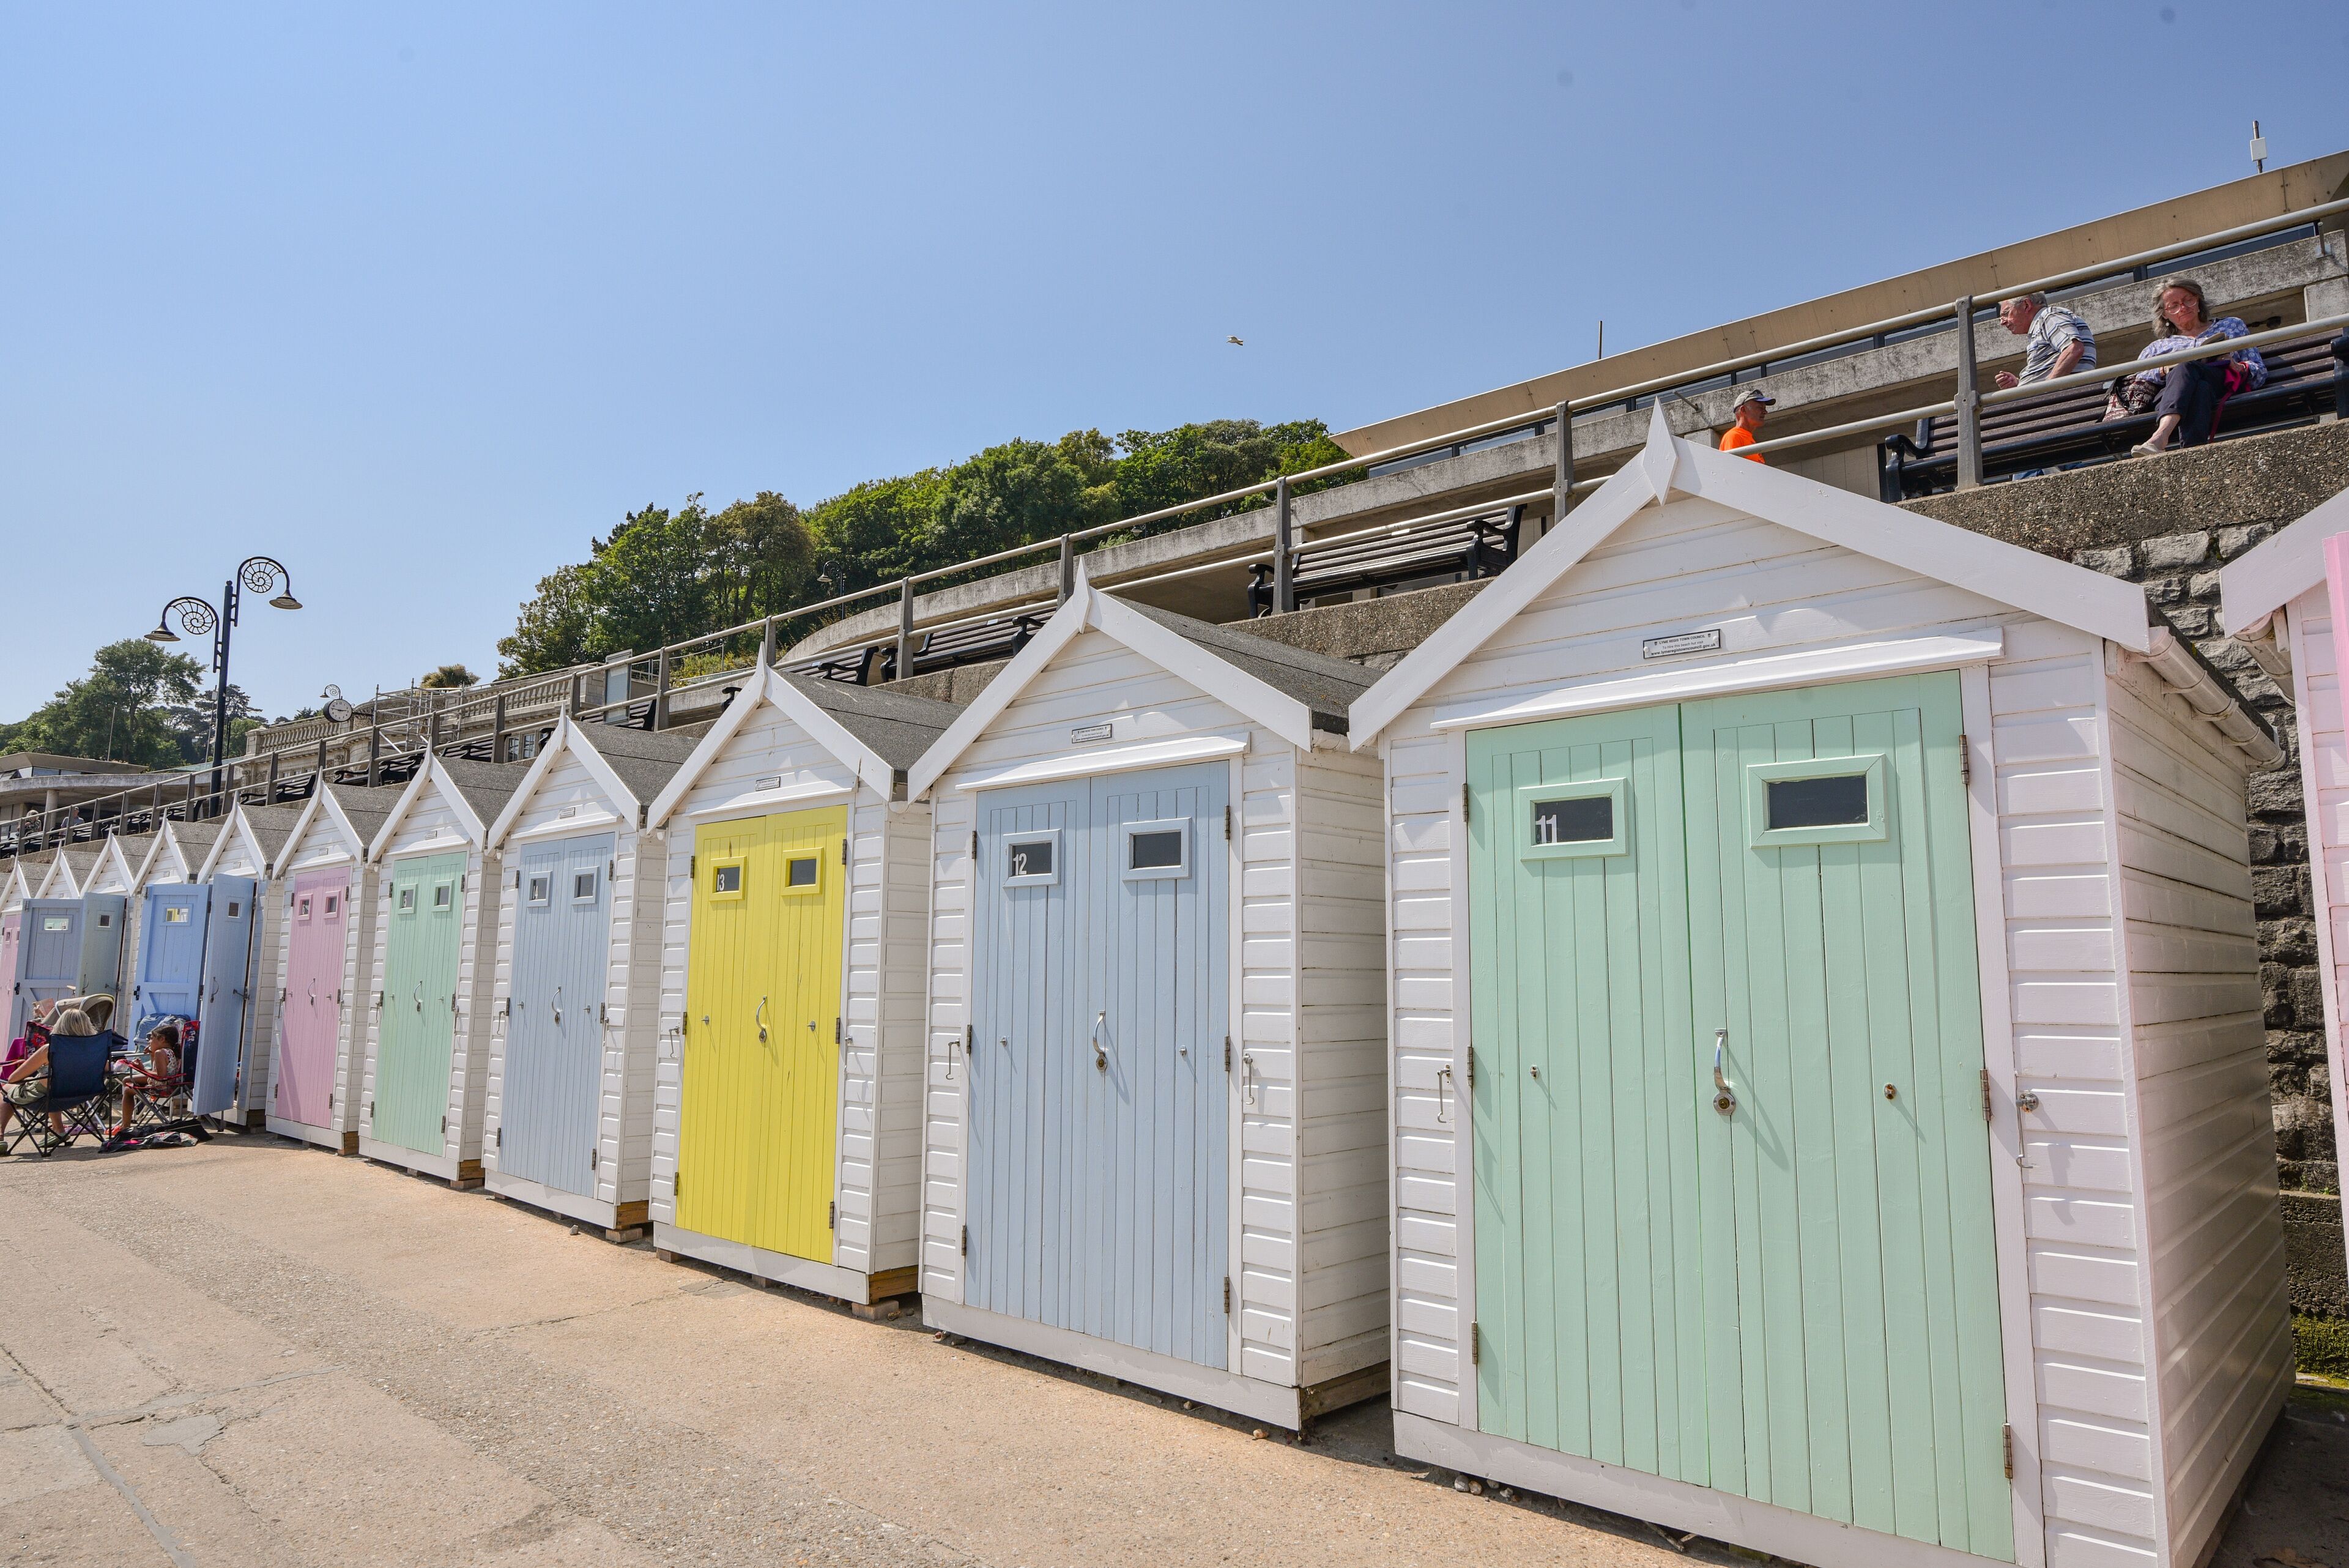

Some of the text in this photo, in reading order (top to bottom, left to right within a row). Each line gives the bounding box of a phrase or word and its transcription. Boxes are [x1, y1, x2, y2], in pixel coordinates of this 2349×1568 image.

[1651, 642, 1716, 656] www.lymeregistowncouncil.gov.uk
[1535, 814, 1557, 844] 11
[1013, 853, 1027, 876] 12
[716, 874, 725, 891] 13
